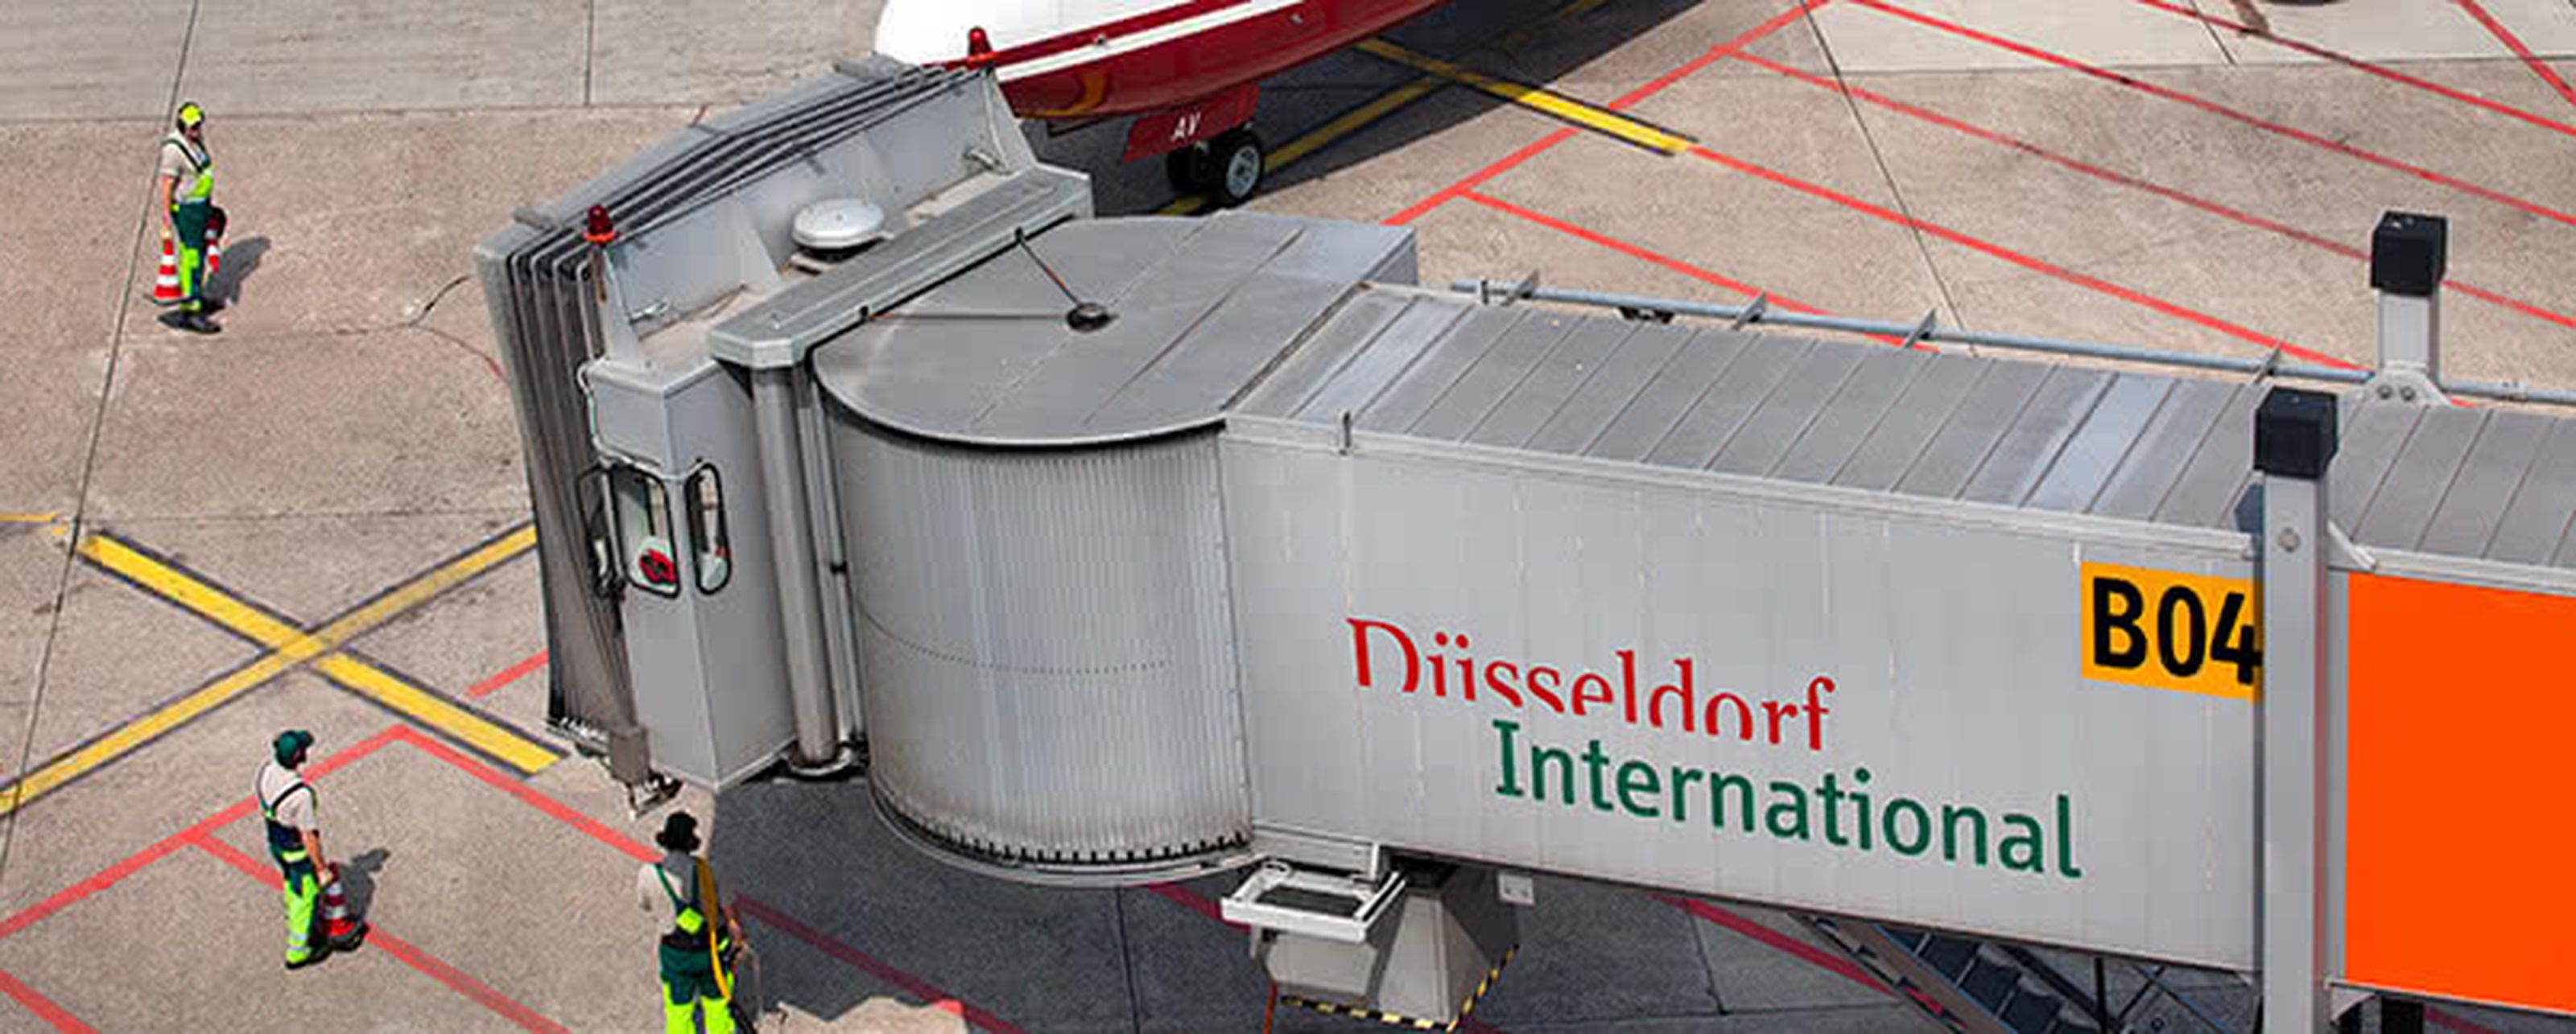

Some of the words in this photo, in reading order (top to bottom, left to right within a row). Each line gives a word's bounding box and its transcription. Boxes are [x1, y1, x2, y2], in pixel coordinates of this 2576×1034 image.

[1170, 112, 1201, 142] AV
[1346, 617, 1835, 752] Düsseldorf
[2093, 577, 2263, 686] B04
[1493, 719, 2083, 881] International
